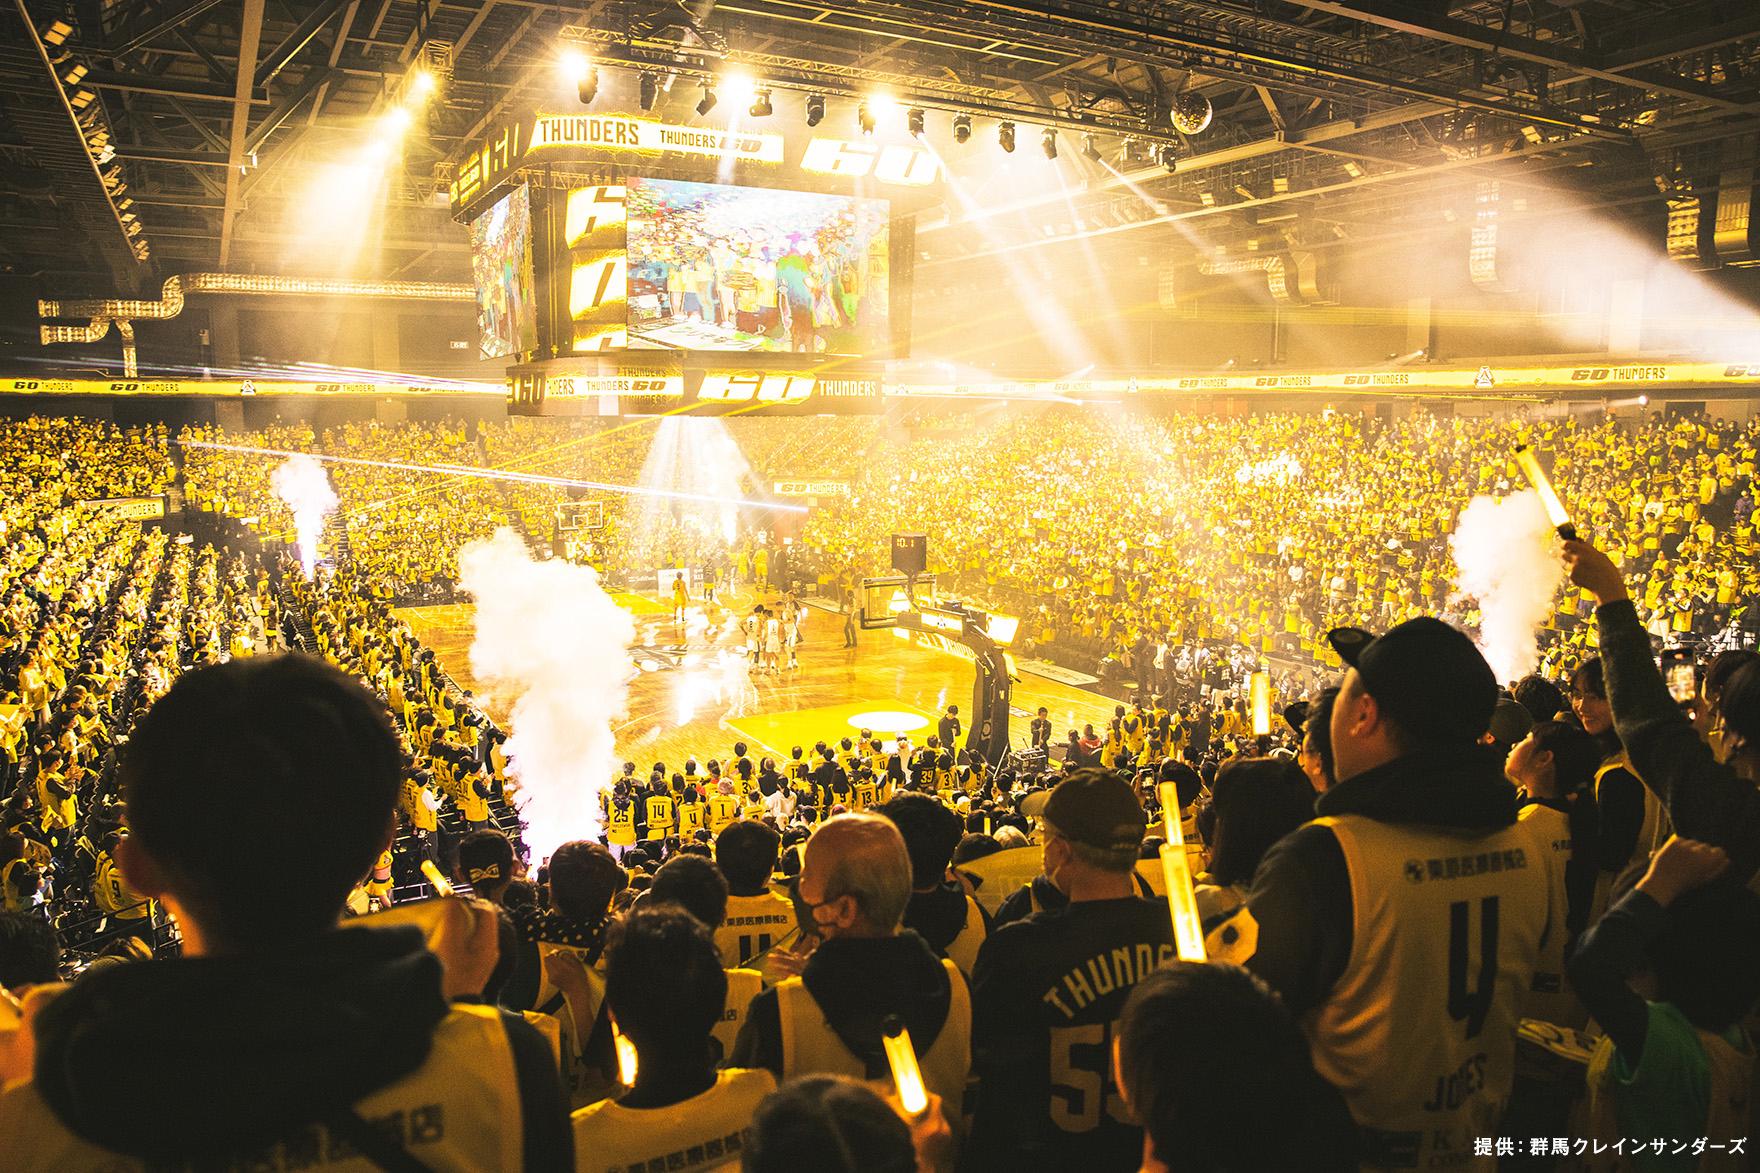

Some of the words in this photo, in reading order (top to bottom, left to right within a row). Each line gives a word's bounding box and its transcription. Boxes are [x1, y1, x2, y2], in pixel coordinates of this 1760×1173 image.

[540, 118, 639, 145] THUNDERS
[660, 129, 716, 148] THUNDERS
[1373, 374, 1409, 385] THUNDERS
[1613, 367, 1666, 380] THUNDERS
[41, 381, 73, 391] THUNDERS
[141, 383, 179, 392] THUNDERS
[343, 384, 376, 392] THUNDERS
[586, 380, 629, 392] THUNDERS
[819, 379, 877, 397] THUNDERS
[1280, 376, 1312, 387] THUNDERS
[921, 769, 934, 784] 39
[862, 790, 872, 804] 13
[614, 809, 629, 823] 25
[653, 804, 665, 819] 14
